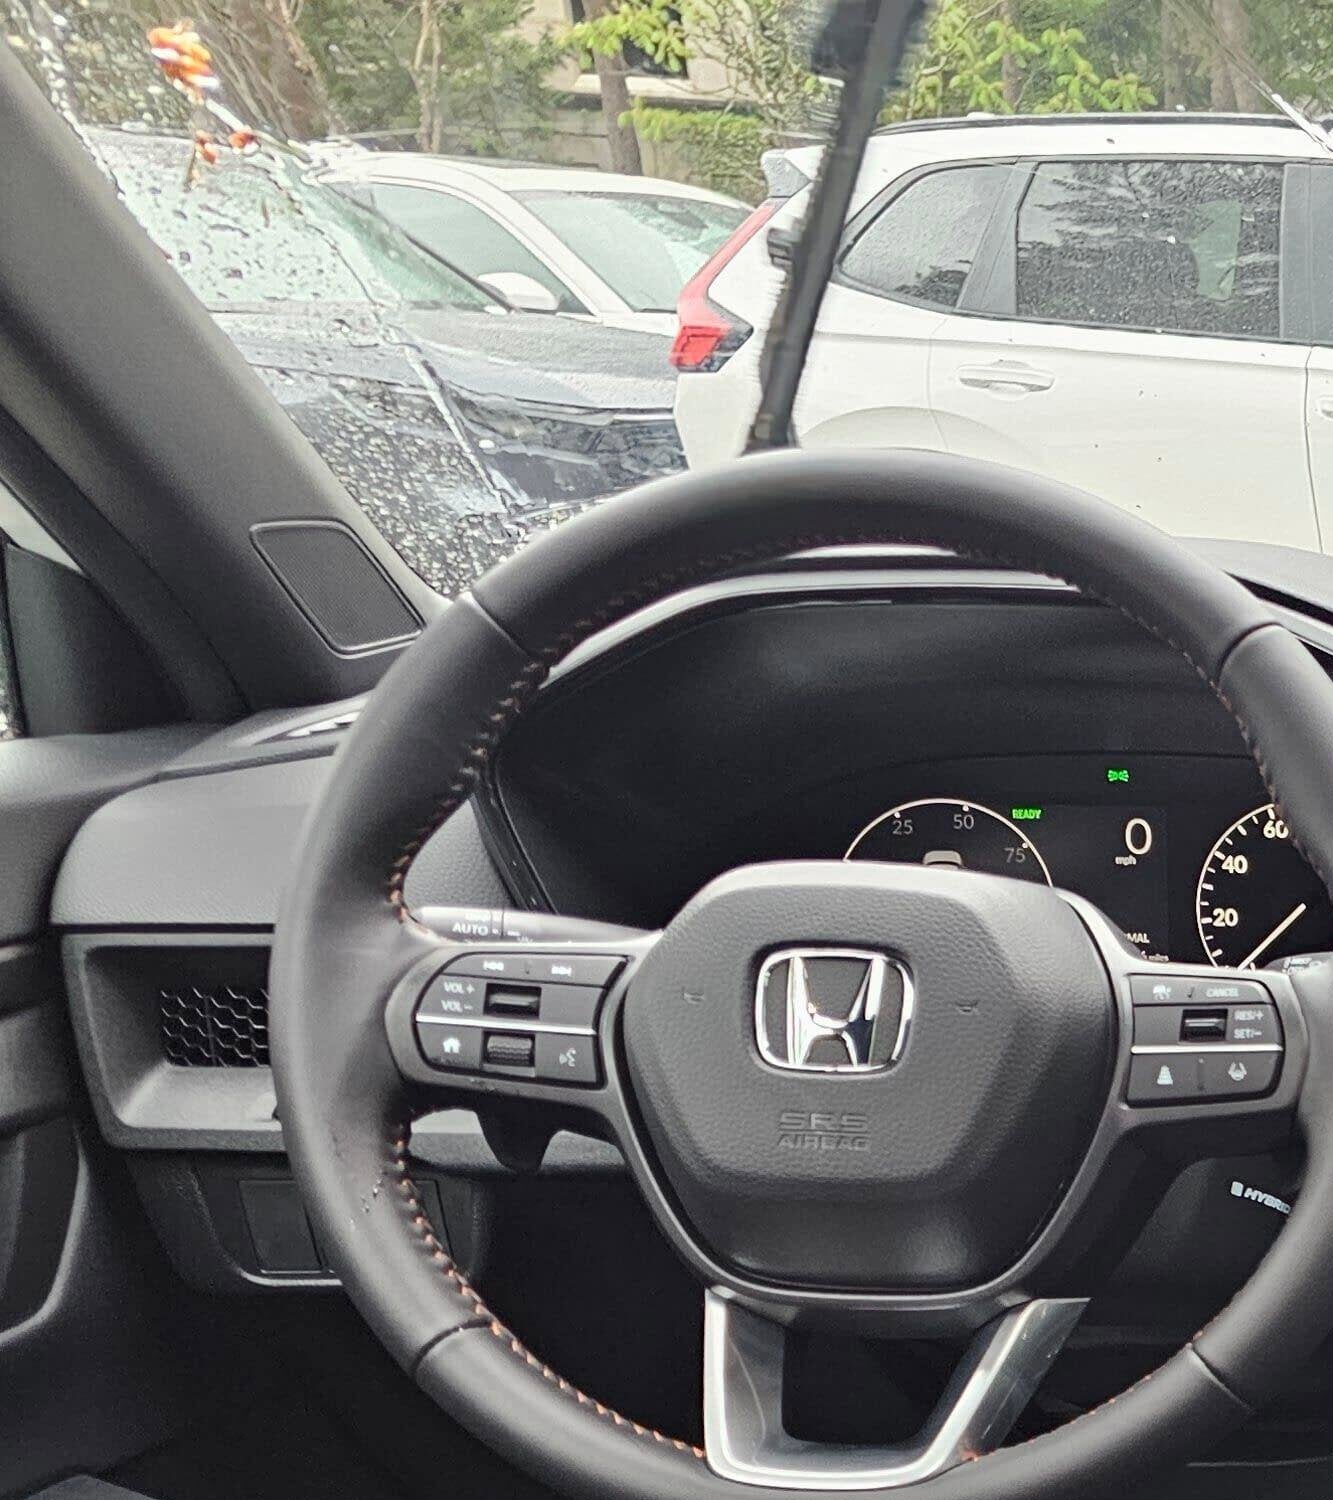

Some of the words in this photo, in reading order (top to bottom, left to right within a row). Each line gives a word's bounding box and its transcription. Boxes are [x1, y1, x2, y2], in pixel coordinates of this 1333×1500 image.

[953, 814, 975, 830] 50
[1012, 808, 1042, 820] READY
[892, 820, 913, 835] 25
[1263, 820, 1290, 838] 60
[1125, 818, 1153, 855] 0
[1004, 847, 1026, 863] 75
[1115, 855, 1137, 866] mph
[1221, 855, 1248, 874] 40
[1212, 908, 1239, 927] 20
[452, 922, 488, 936] AUTO
[443, 981, 464, 994] VOL
[1206, 988, 1240, 998] CANCEL
[441, 1000, 463, 1013] VOL
[779, 1111, 869, 1132] SRS
[777, 1134, 872, 1152] AIRBAG
